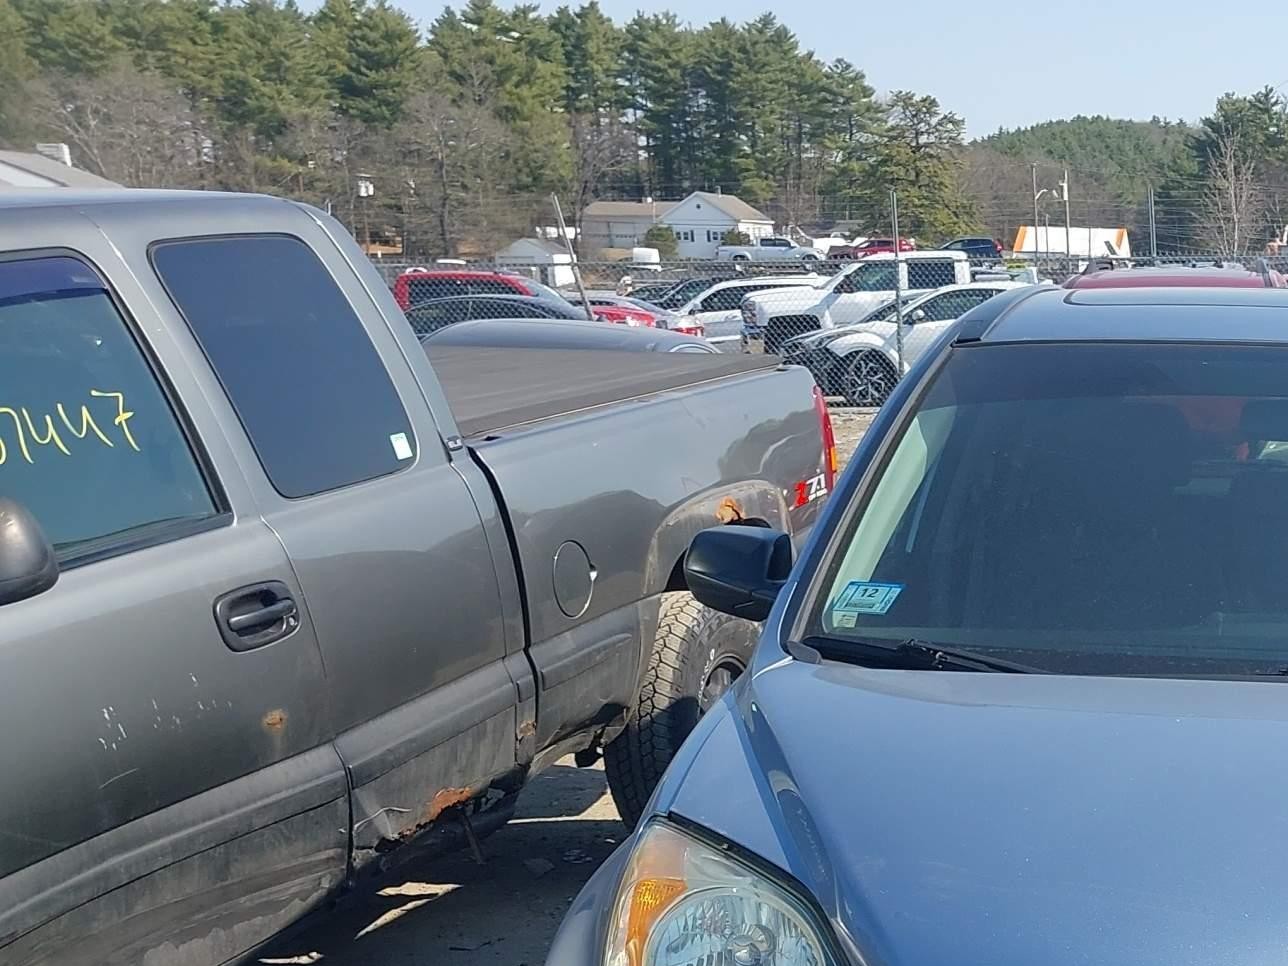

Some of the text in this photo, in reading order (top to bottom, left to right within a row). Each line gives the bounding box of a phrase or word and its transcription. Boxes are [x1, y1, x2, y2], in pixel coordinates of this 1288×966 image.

[0, 389, 142, 465] 7447
[789, 473, 828, 511] Z71
[860, 588, 880, 598] 12
